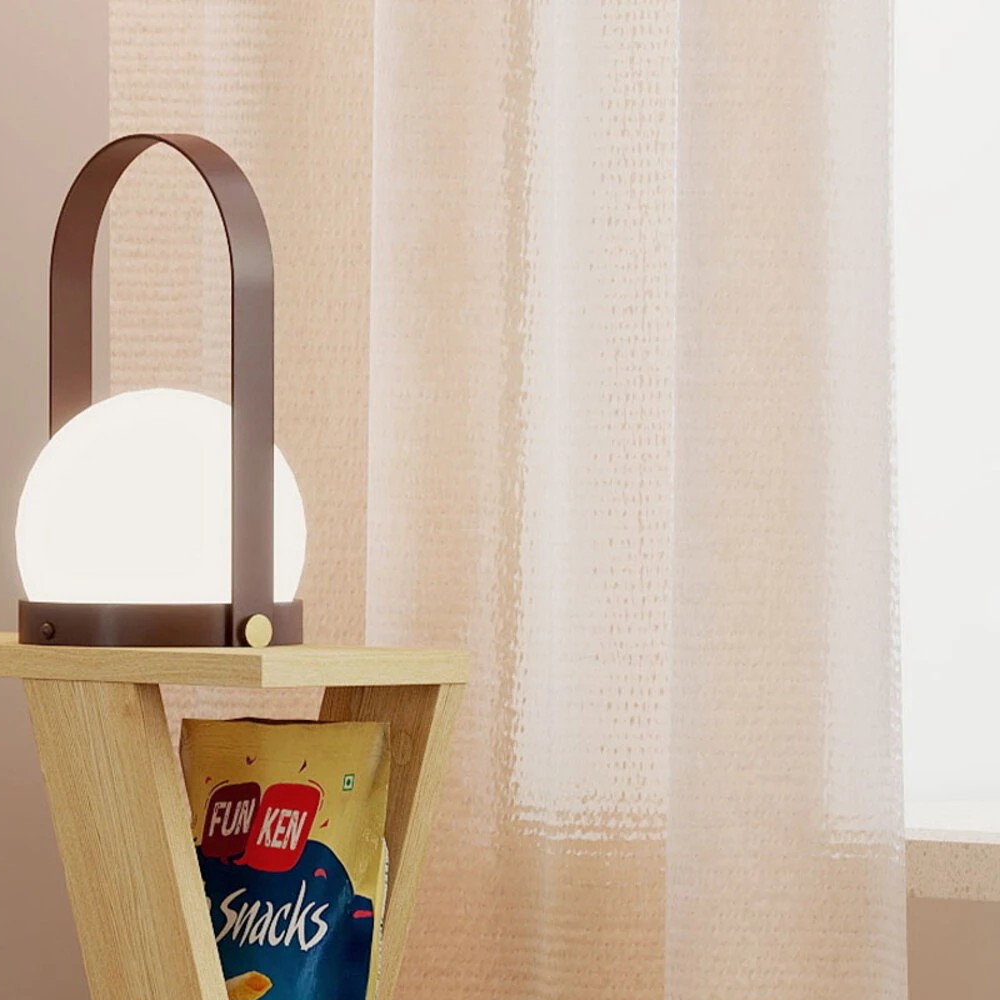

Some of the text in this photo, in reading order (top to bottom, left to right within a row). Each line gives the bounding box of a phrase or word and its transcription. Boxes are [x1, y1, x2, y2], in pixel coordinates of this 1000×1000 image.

[208, 798, 256, 837] FUN
[256, 806, 307, 851] KEN
[216, 879, 329, 951] Snacks
